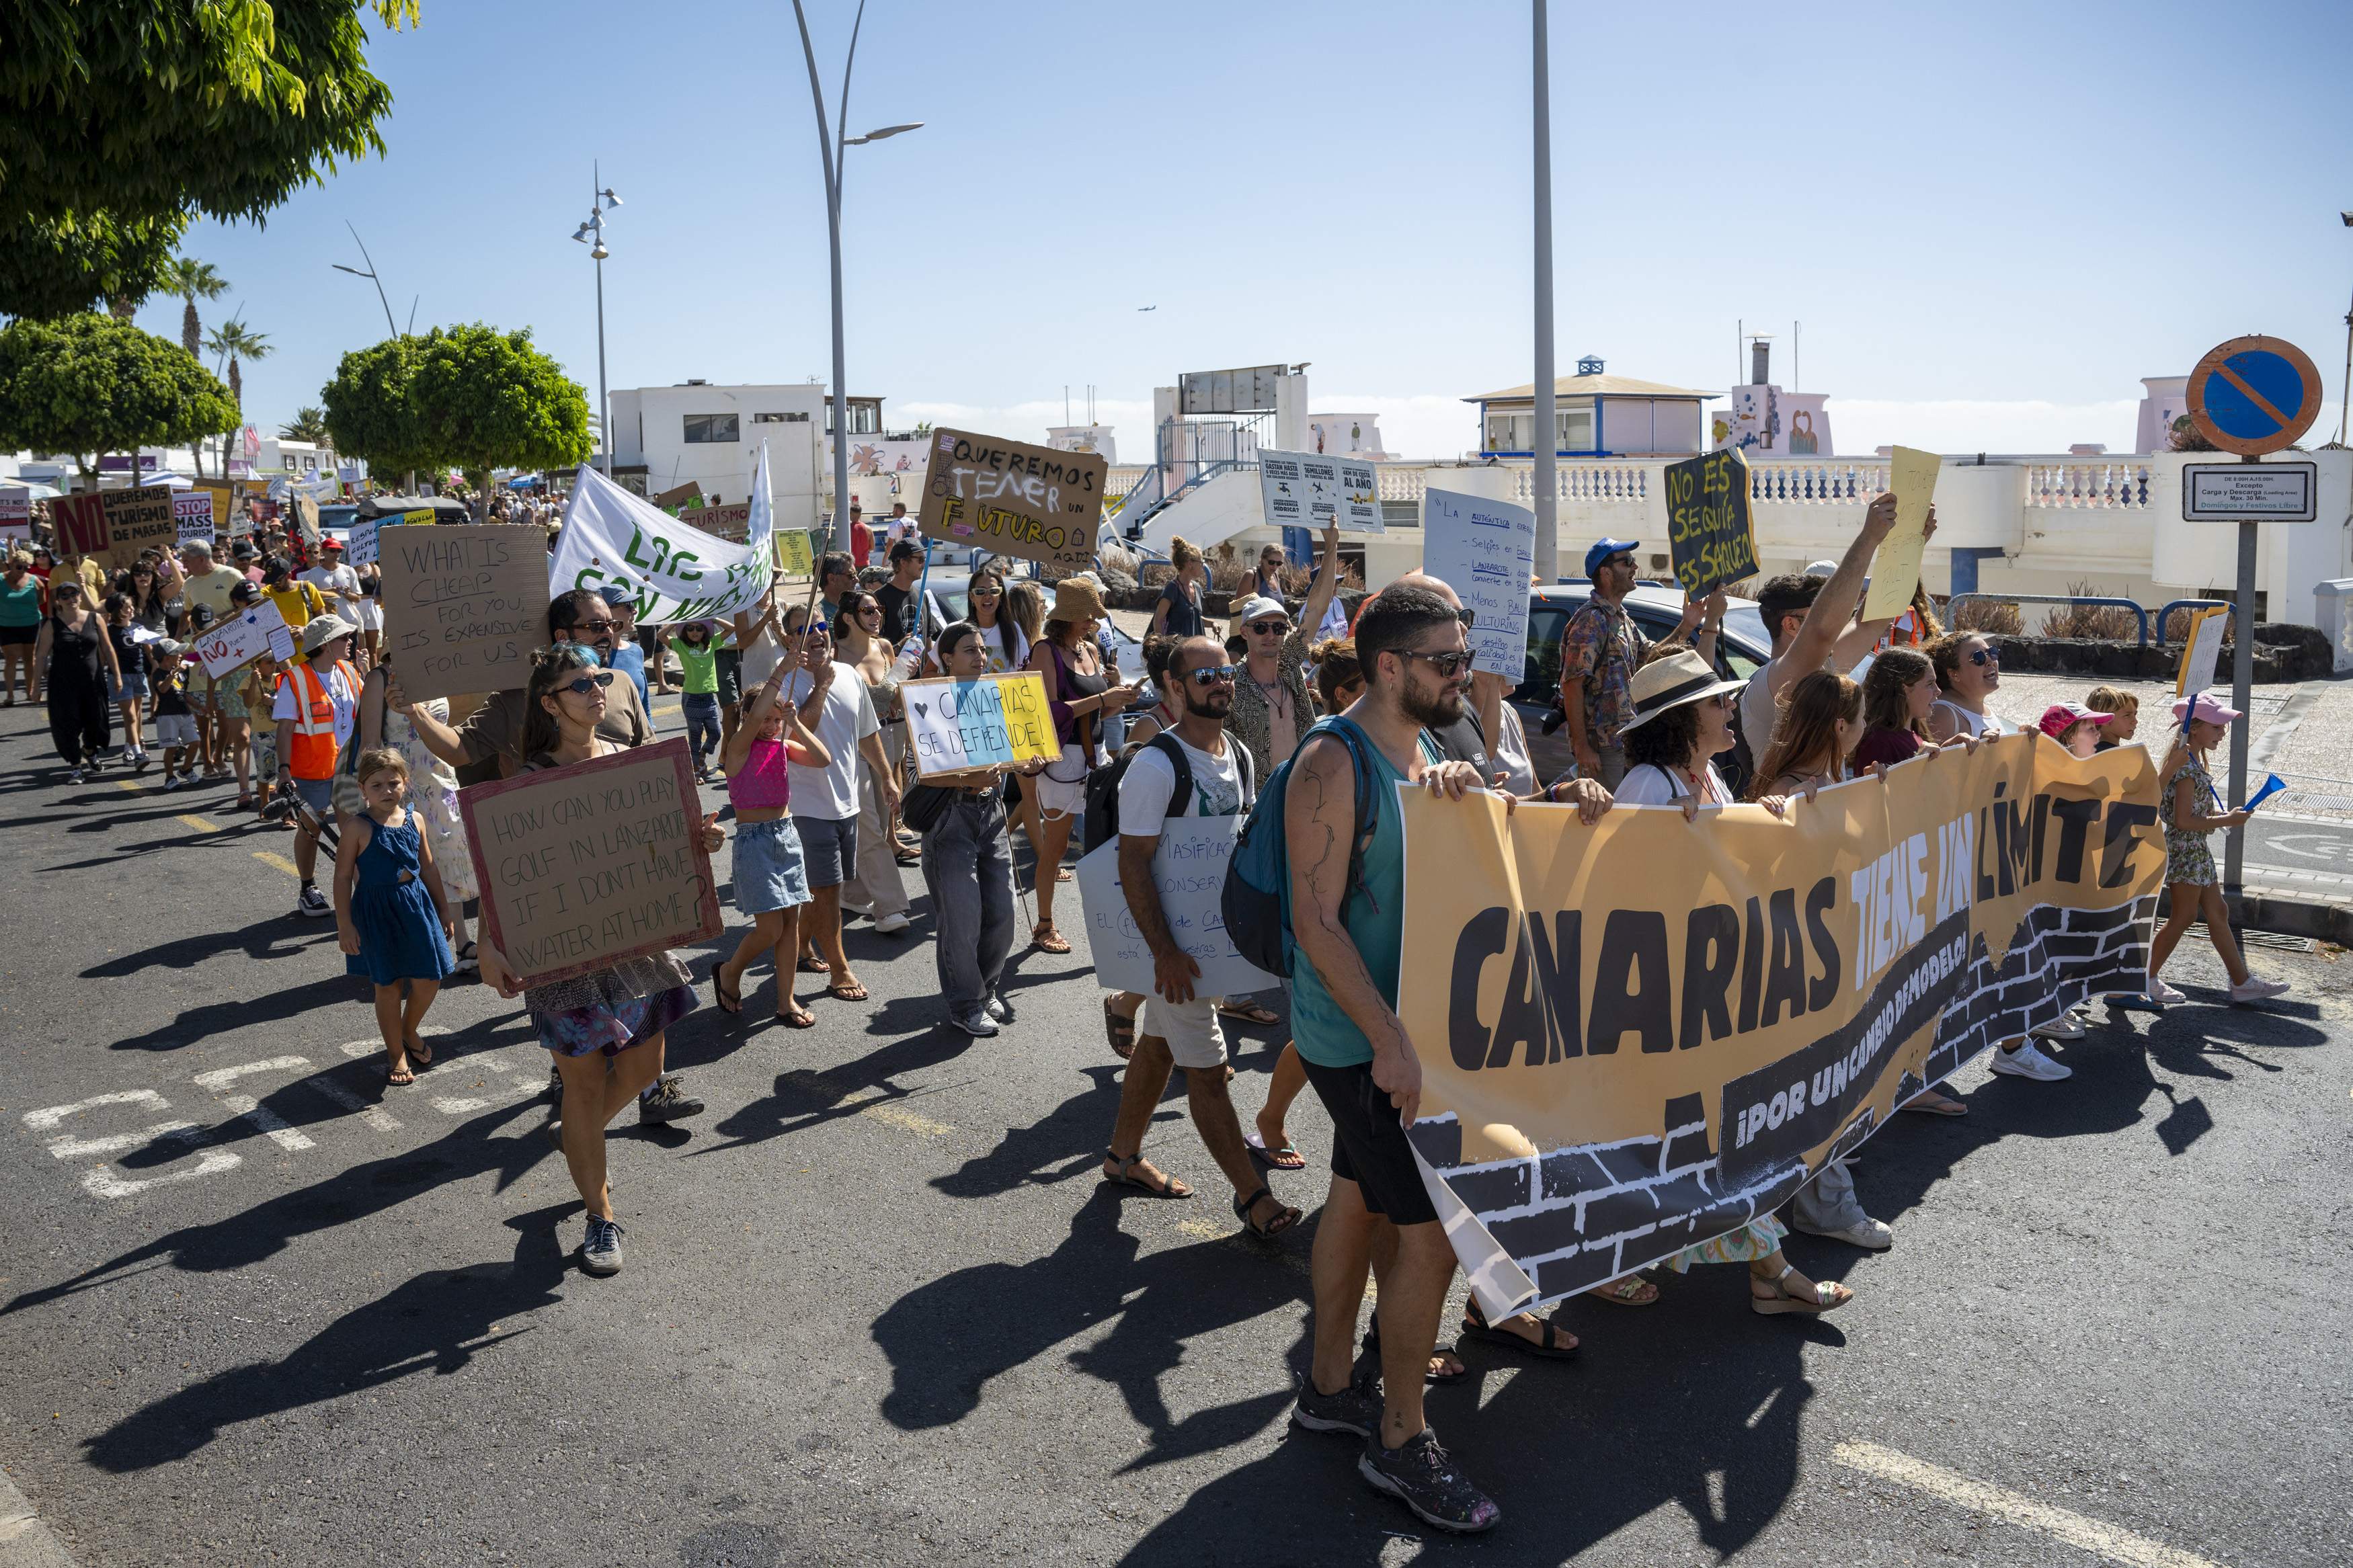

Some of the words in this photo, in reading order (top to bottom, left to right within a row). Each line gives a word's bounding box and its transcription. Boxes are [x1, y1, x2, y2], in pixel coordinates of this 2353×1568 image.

[954, 440, 1094, 491] QUEREMOS
[951, 468, 1061, 513] TENER
[1344, 477, 1354, 488] AL
[1355, 477, 1372, 490] AÑO
[1669, 468, 1694, 510] NO
[1703, 454, 1731, 494] ES
[103, 488, 168, 508] QUEREMOS
[175, 499, 210, 515] STOP
[1068, 503, 1084, 513] UN
[53, 494, 109, 555] NO
[112, 528, 130, 542] DE
[132, 522, 172, 540] MASAS
[175, 515, 212, 529] MASS
[177, 528, 213, 538] TOURISM
[684, 509, 748, 528] TURISMO
[1673, 493, 1735, 543] SEQUÍA
[401, 536, 477, 574] WHAT
[479, 538, 510, 567] IS
[1679, 559, 1700, 592] ES
[1700, 532, 1752, 583] SAQUEO
[410, 572, 492, 604] CHEAP
[1472, 591, 1498, 608] Menos
[438, 602, 478, 624] FOR
[484, 597, 525, 616] YOU,
[199, 618, 245, 648] LANZAROTE
[401, 629, 430, 651] IS
[444, 620, 534, 643] EXPENSIVE
[1481, 635, 1508, 649] destino
[202, 640, 228, 663] NO
[424, 652, 470, 676] FOR
[483, 641, 518, 663] US
[1490, 661, 1503, 671] EN
[939, 683, 1037, 720] CANARIAS
[918, 731, 944, 757] SE
[491, 804, 545, 845] HOW
[552, 793, 594, 826] CAN
[600, 786, 635, 814] YOU
[639, 773, 674, 806] PLAY
[500, 846, 557, 888] GOLF
[569, 835, 596, 866] IN
[602, 808, 689, 856] LANZAROTE
[510, 892, 540, 927] IF
[552, 882, 569, 915] I
[578, 862, 636, 906] DON'T
[642, 845, 693, 884] HAVE
[1096, 913, 1114, 930] EL
[1175, 914, 1194, 930] de
[1448, 876, 1841, 1071] CANARIAS
[1851, 831, 1928, 992] TIENE
[1936, 811, 1973, 924] UN
[1977, 781, 2158, 903] LÍMITE
[514, 923, 597, 969] WATER
[603, 910, 625, 947] AT
[1735, 1080, 1807, 1151] ¡POR
[1810, 1055, 1849, 1107] UN
[1849, 999, 1895, 1083] CAMBIO
